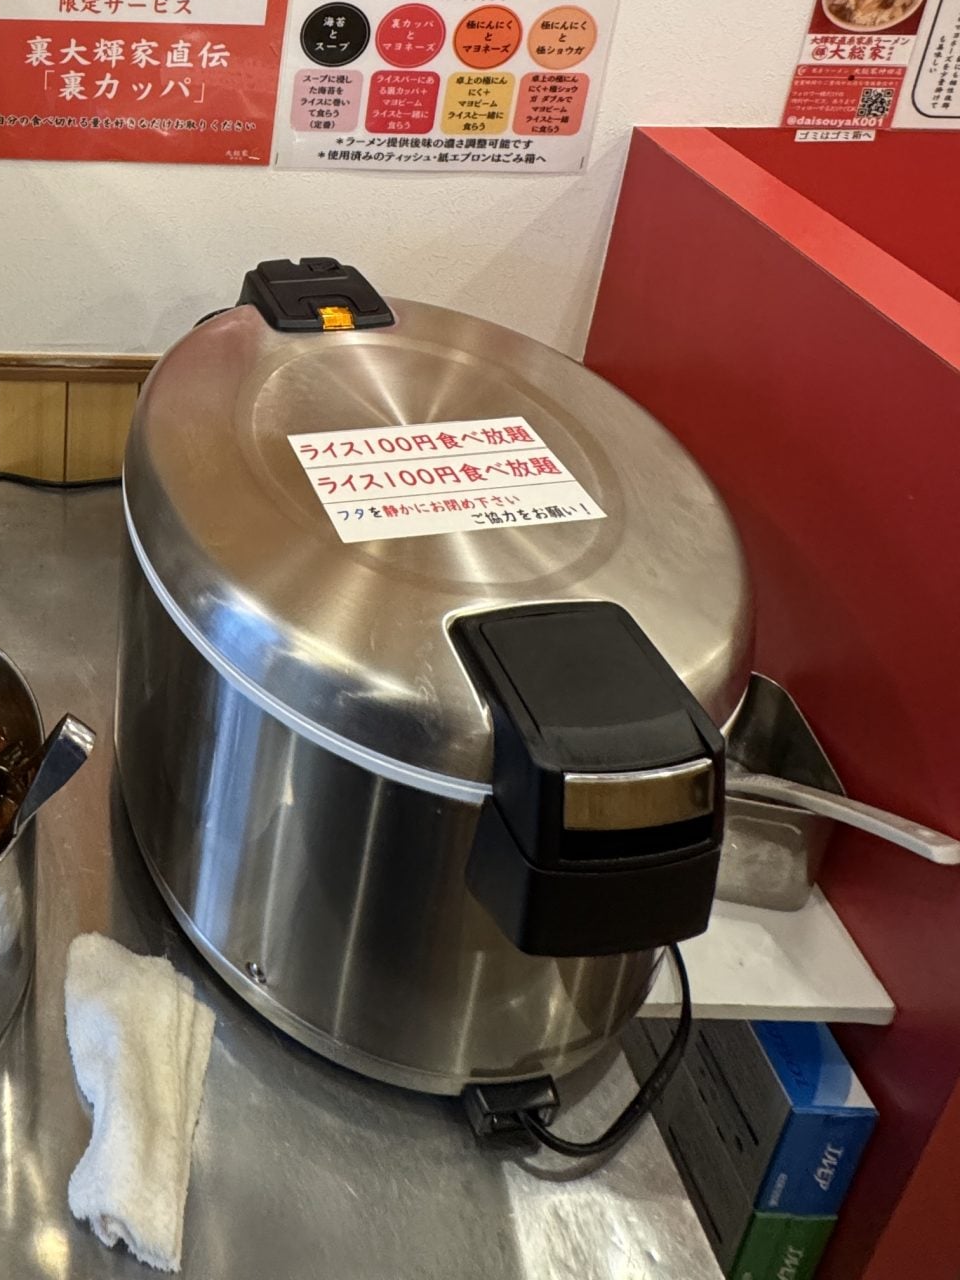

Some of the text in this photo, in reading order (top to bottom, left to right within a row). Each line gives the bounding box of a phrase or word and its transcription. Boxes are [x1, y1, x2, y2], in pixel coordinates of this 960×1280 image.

[24, 35, 231, 69] 裏大輝家直伝
[315, 41, 351, 53] スープ
[43, 69, 206, 104] 「裏カッパ」
[299, 425, 535, 462] ライス100円食べ放題
[317, 457, 563, 495] ライス100円食べ放題
[337, 494, 521, 522] フタを静かにお閉め下さい
